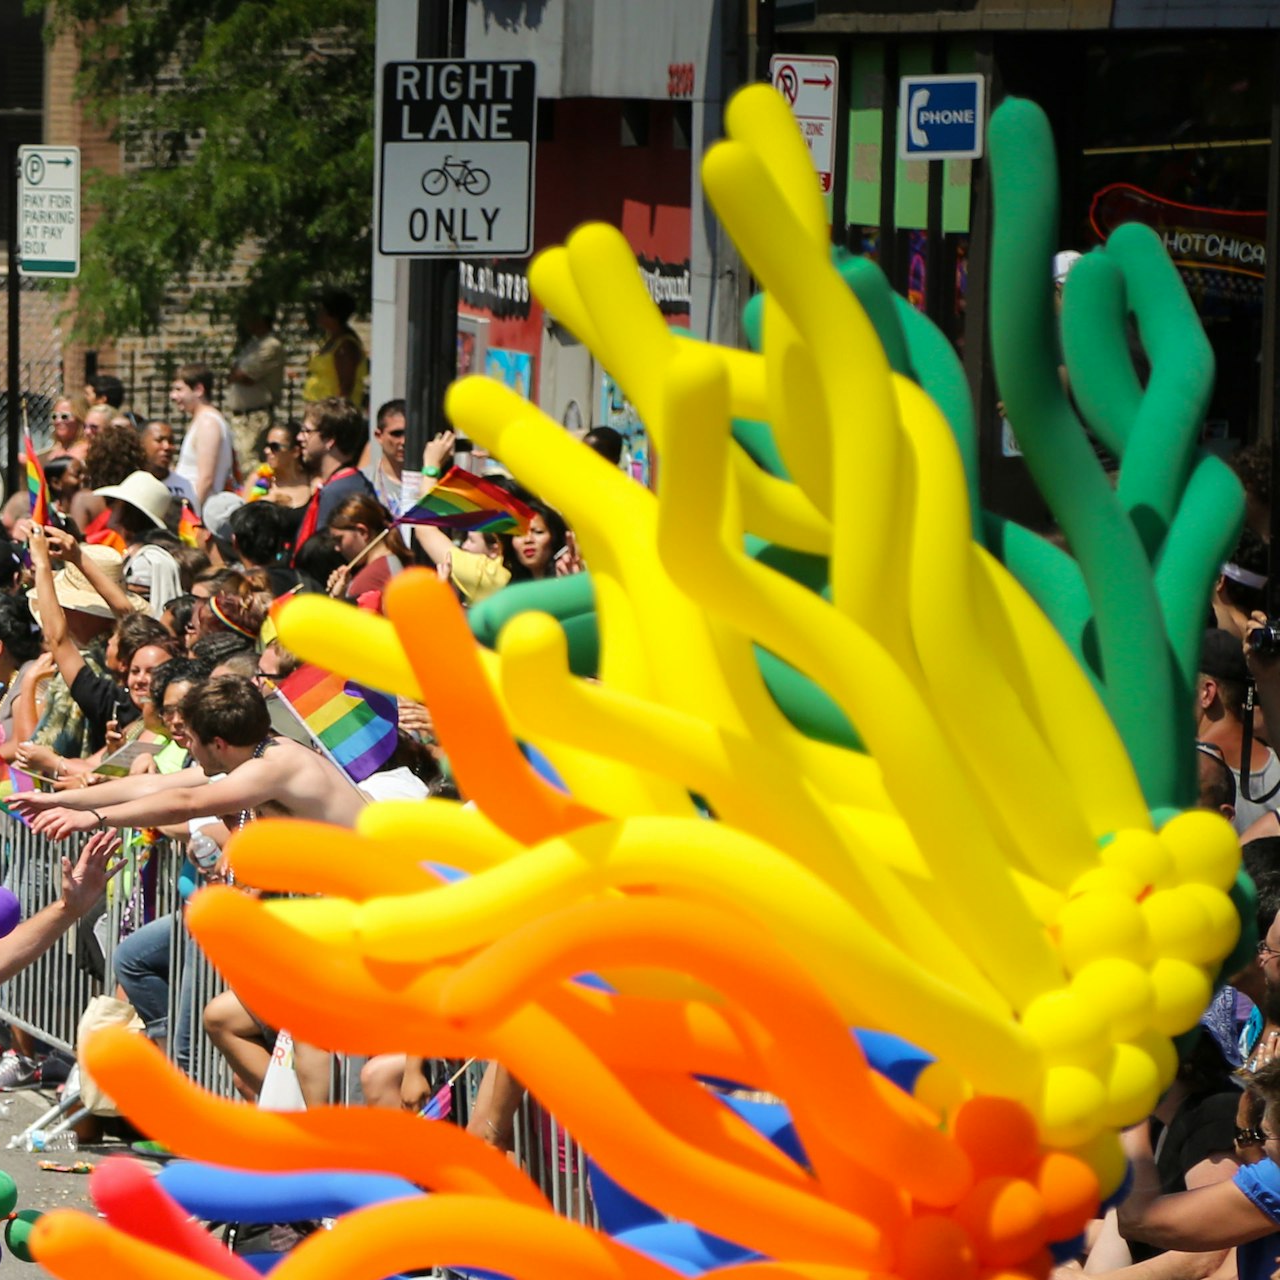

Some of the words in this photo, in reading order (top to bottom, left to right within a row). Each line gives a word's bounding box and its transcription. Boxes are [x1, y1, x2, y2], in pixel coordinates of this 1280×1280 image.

[396, 64, 522, 101] RIGHT
[401, 103, 513, 140] LANE
[920, 109, 975, 125] PHONE
[24, 194, 46, 207] PAY
[49, 195, 73, 208] FOR
[24, 210, 75, 225] PARKING
[409, 207, 501, 243] ONLY
[25, 226, 40, 239] AT
[42, 226, 65, 240] PAY
[24, 241, 48, 255] BOX
